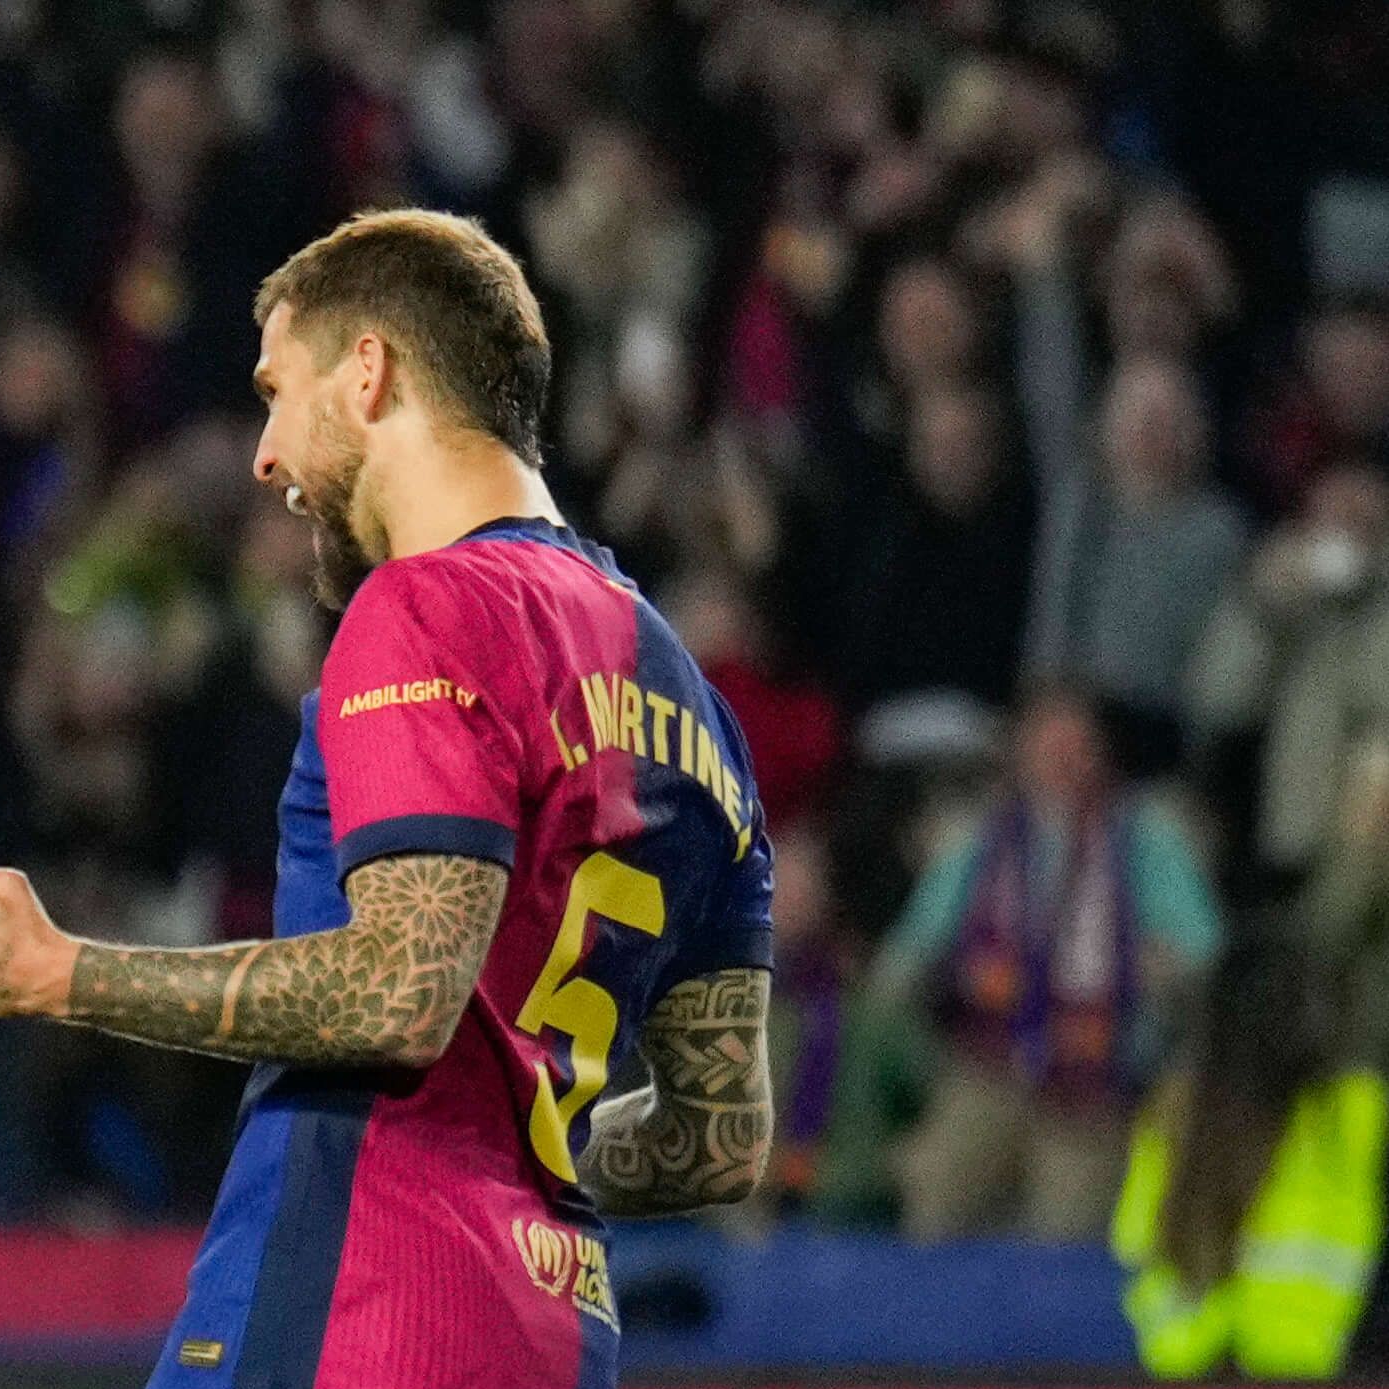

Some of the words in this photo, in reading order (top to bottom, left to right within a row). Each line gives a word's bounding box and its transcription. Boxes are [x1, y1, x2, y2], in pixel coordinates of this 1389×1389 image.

[339, 678, 452, 719] AMBILIGHT
[550, 707, 589, 772] I.
[580, 672, 754, 864] MRTINE
[515, 850, 666, 1184] 5
